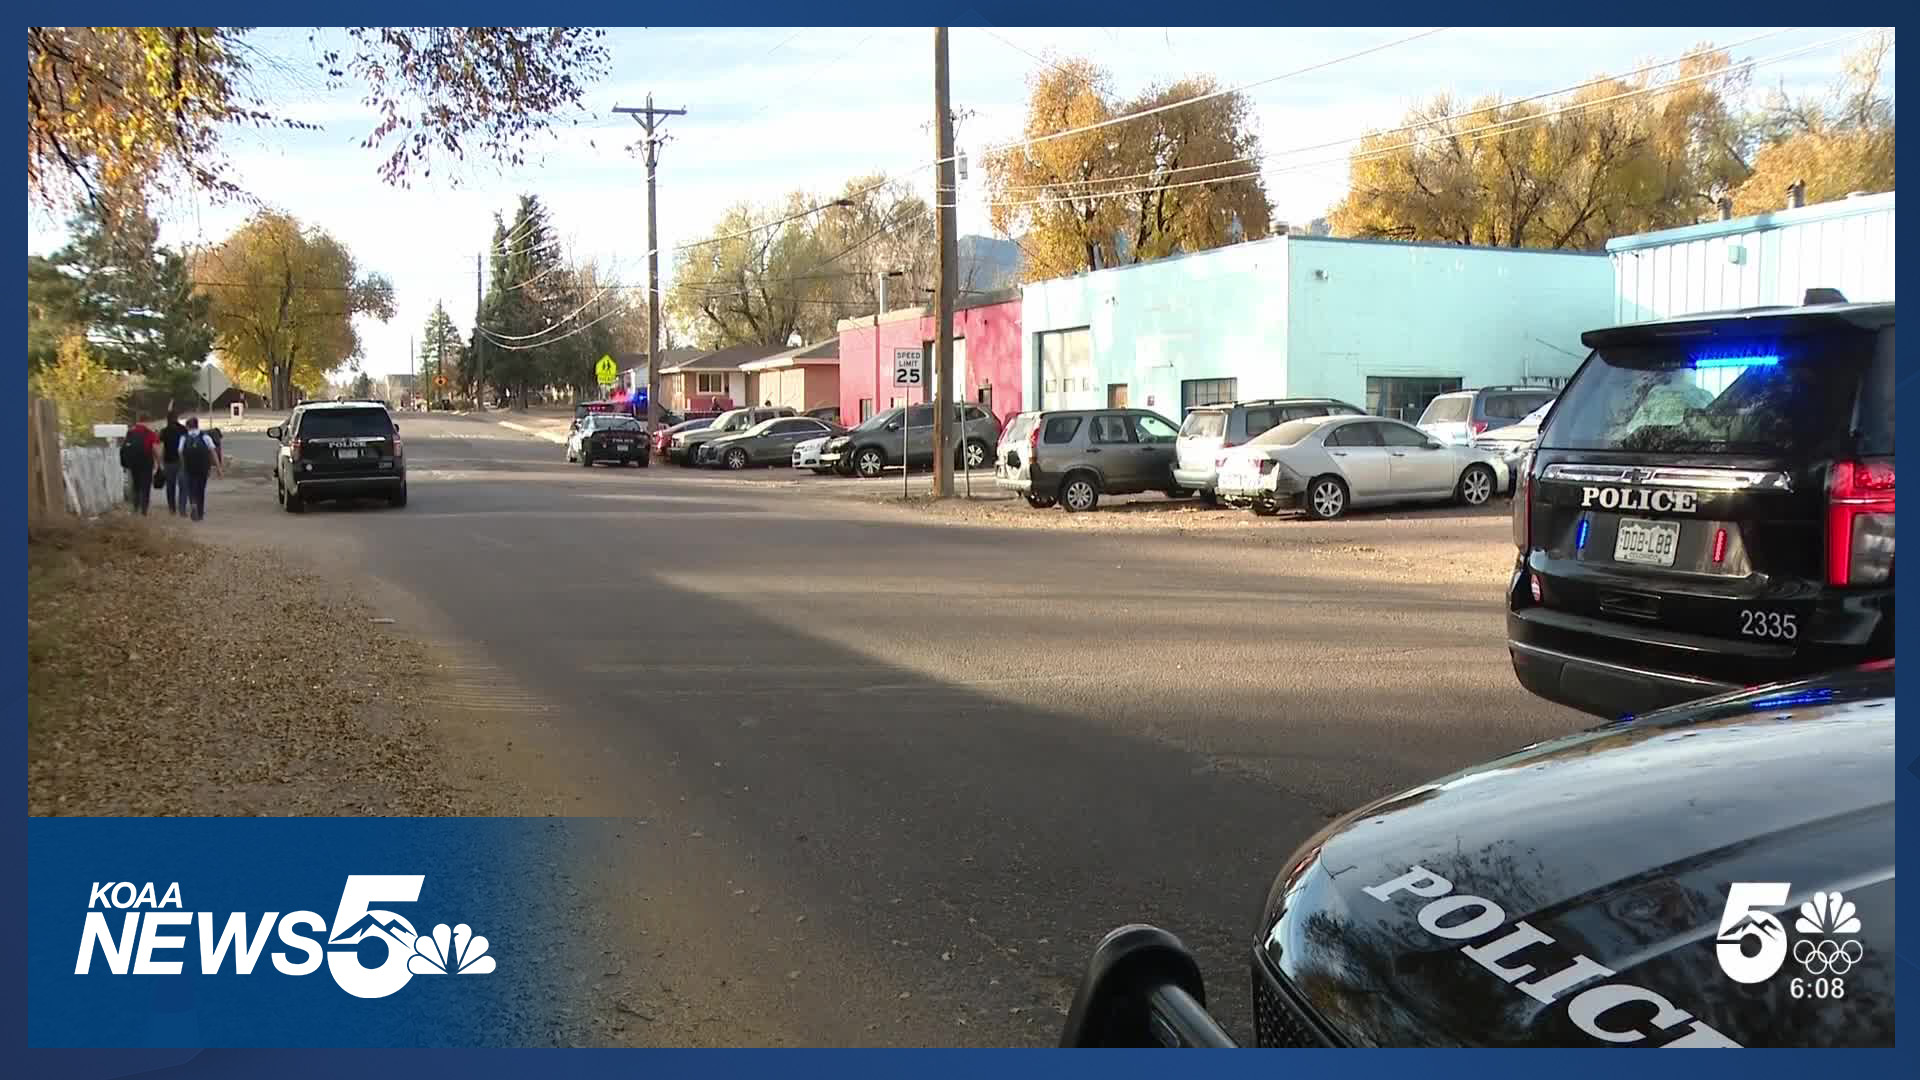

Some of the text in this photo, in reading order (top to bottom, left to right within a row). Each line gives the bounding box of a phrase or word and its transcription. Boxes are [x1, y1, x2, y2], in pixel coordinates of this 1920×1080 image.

[896, 368, 920, 383] 25
[1580, 486, 1697, 512] POLICE
[1741, 610, 1797, 639] 2335
